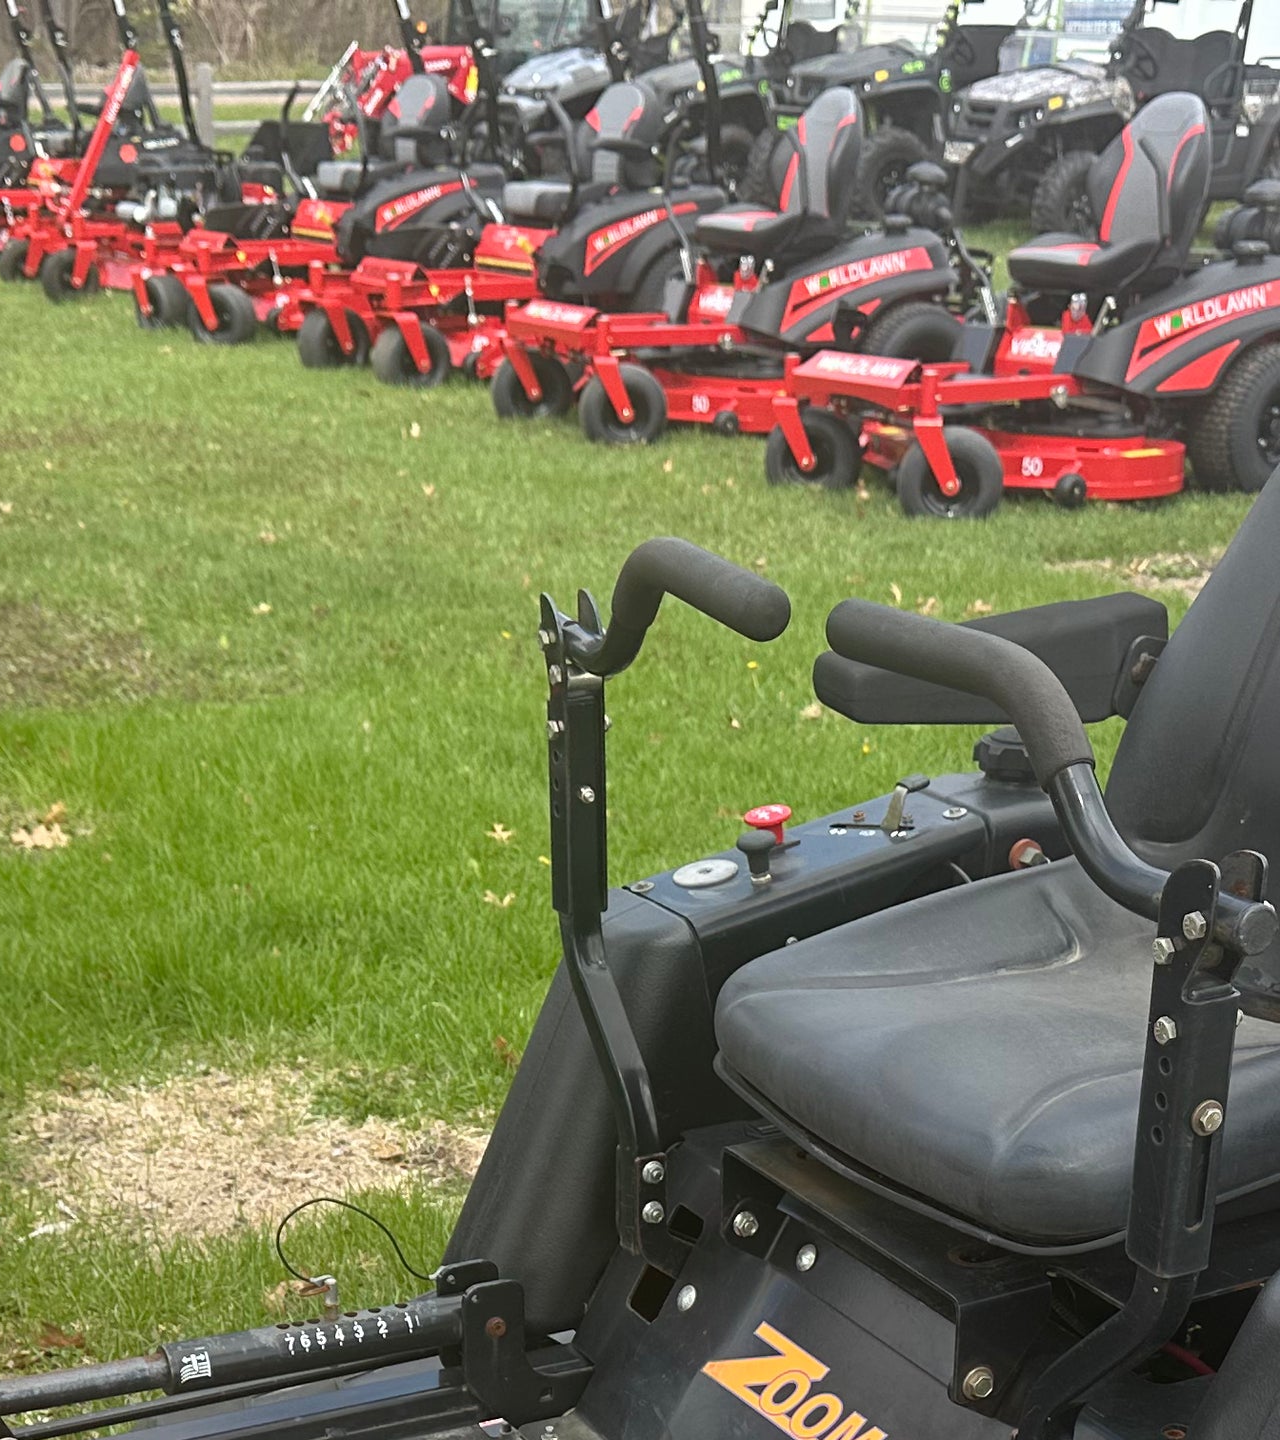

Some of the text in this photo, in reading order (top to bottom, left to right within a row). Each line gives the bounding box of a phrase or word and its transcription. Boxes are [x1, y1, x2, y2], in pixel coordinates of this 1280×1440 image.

[1153, 285, 1268, 338] WORLDLAWN
[1021, 456, 1043, 477] 50
[284, 1315, 413, 1351] 7 6 5 4 3 2 1
